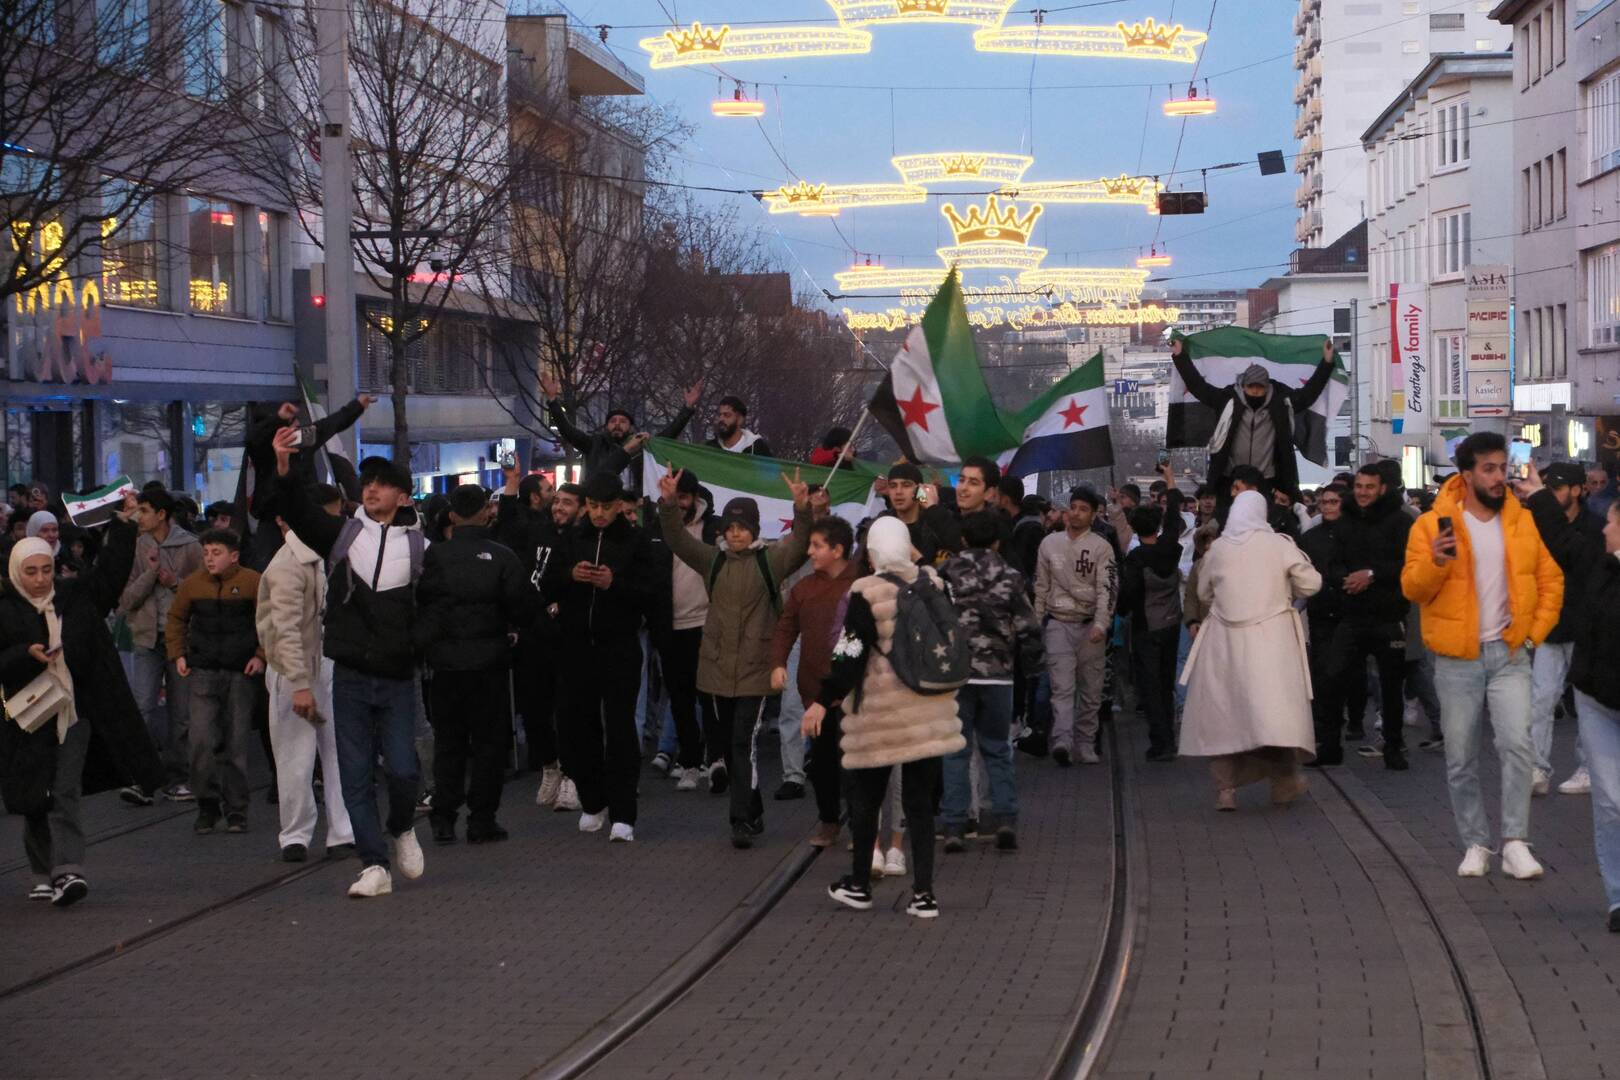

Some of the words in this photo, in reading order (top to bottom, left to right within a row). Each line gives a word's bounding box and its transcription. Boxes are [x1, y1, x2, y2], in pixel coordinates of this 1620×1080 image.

[1470, 273, 1507, 286] ASIA
[1469, 311, 1508, 321] PACIFIC
[1403, 303, 1423, 353] family
[1484, 342, 1492, 351] &
[1408, 354, 1426, 413] Ernsting's
